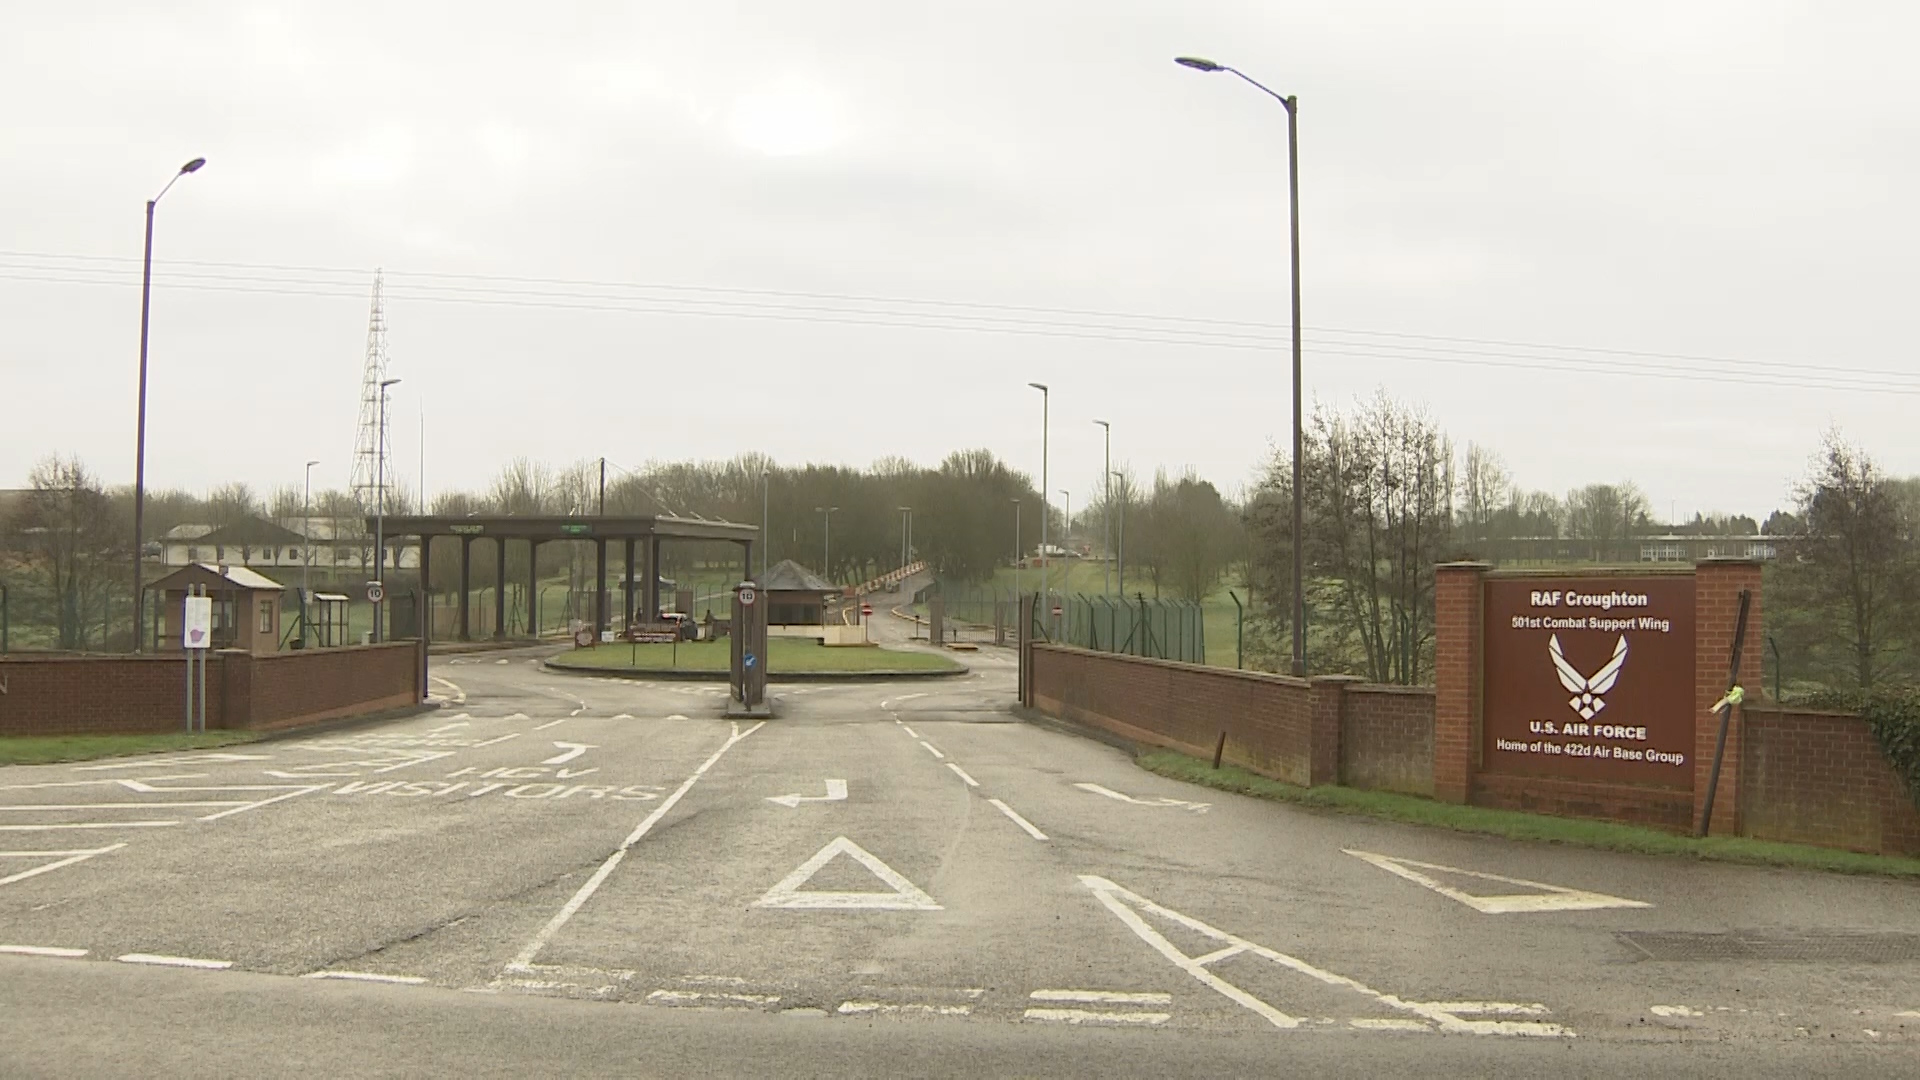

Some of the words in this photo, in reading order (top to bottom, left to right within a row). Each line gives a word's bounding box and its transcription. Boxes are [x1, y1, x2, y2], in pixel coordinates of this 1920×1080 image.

[370, 589, 381, 598] 10
[1530, 591, 1561, 606] RAF
[1565, 591, 1648, 610] Croughton
[1512, 616, 1541, 628] 501st
[1543, 616, 1586, 629] Combat
[1589, 617, 1636, 632] Support
[1638, 618, 1670, 632] Wing
[1529, 721, 1559, 734] U.S.
[1562, 723, 1590, 736] AIR
[1593, 725, 1647, 740] FORCE
[1496, 738, 1528, 751] Home
[1530, 741, 1542, 753] of
[1543, 743, 1562, 754] the
[1564, 743, 1591, 757] 422d
[1593, 744, 1611, 758] Air
[1613, 747, 1642, 761] Base
[1645, 749, 1684, 766] Group
[447, 766, 600, 779] HGV
[332, 780, 666, 800] VISITORS
